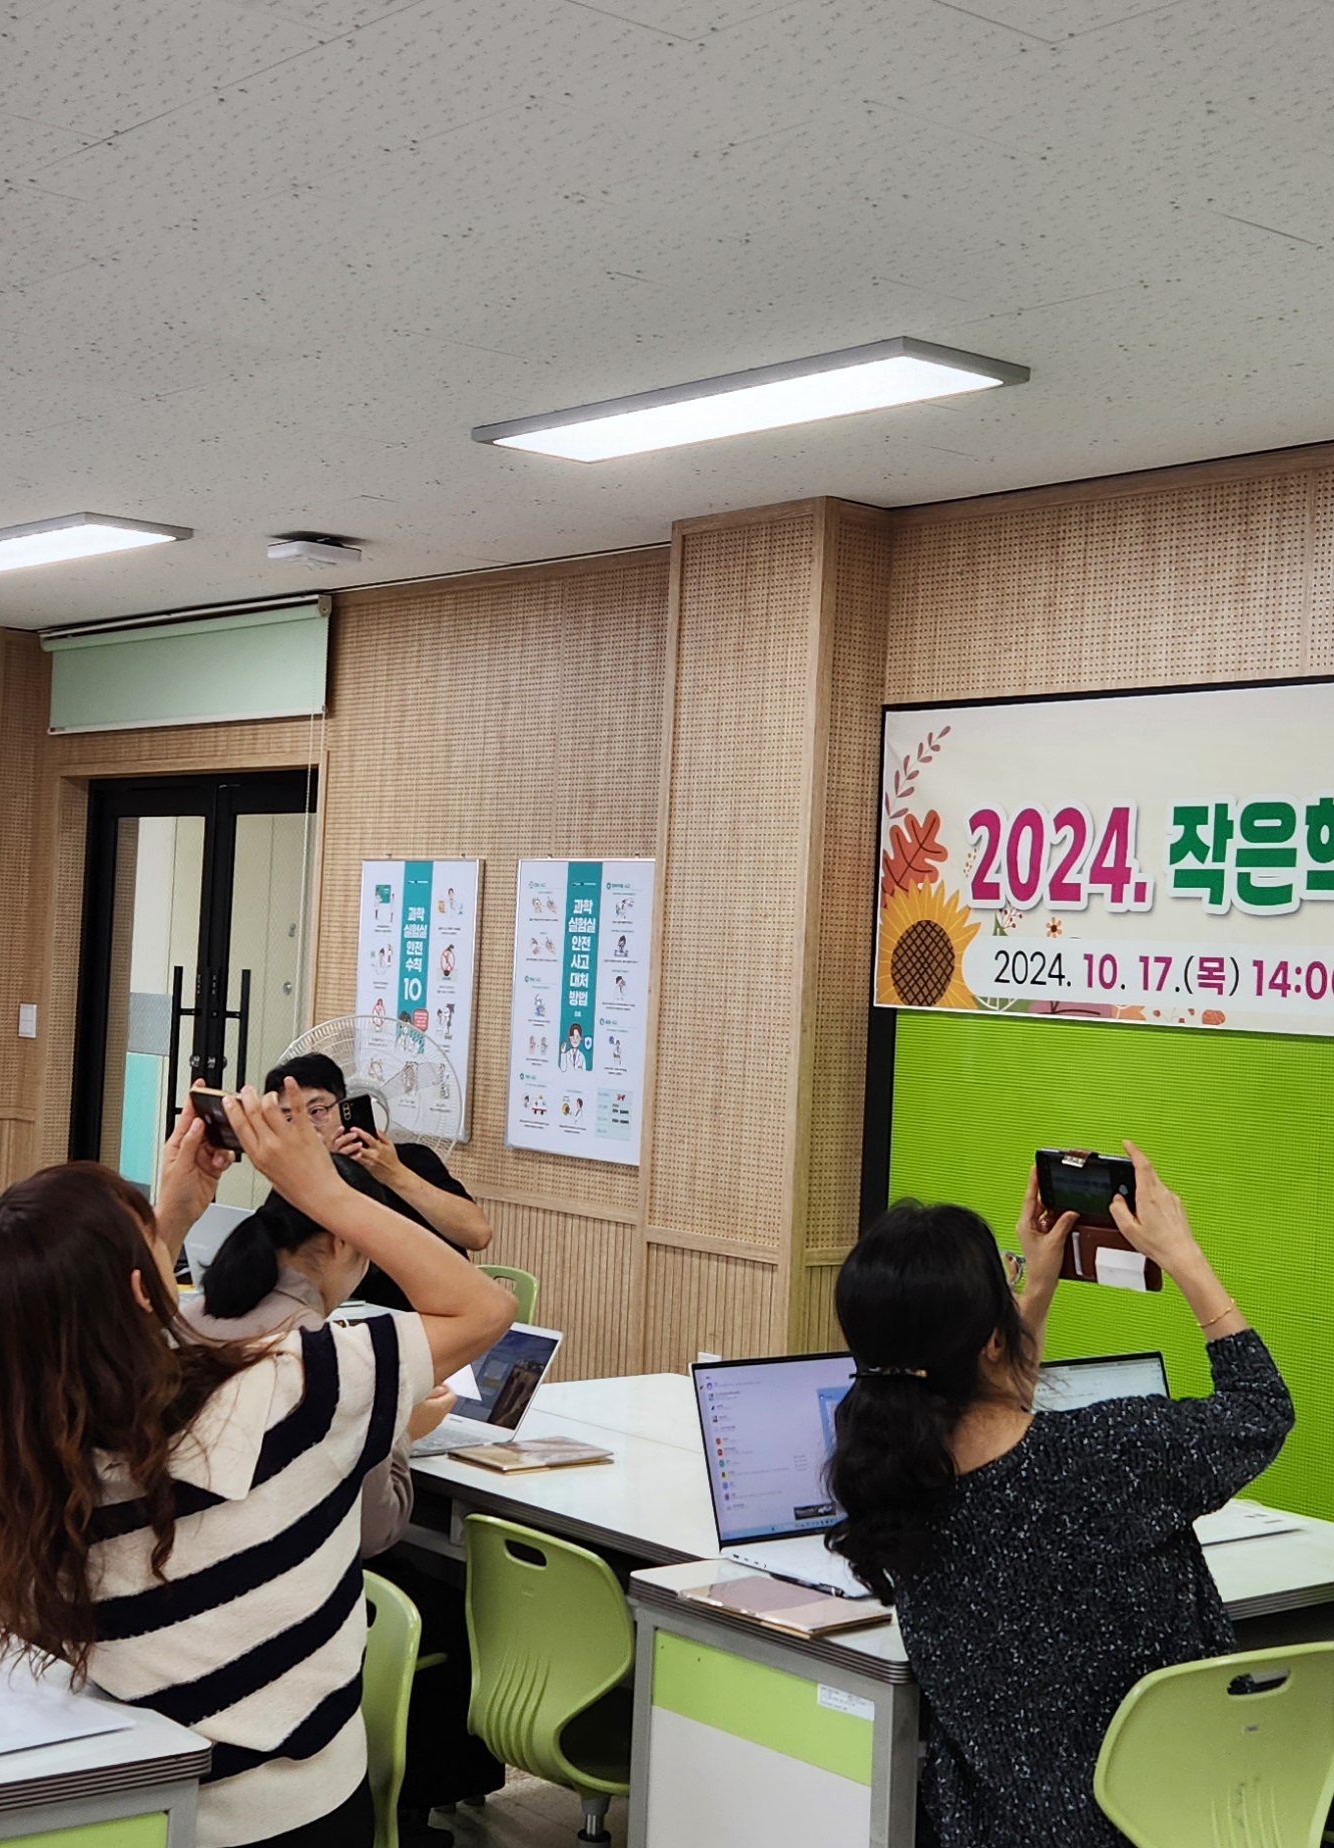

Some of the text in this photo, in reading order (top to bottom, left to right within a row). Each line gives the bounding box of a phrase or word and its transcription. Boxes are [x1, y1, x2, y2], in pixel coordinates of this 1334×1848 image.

[969, 805, 1146, 905] 2024.
[407, 907, 425, 922] 과학
[573, 899, 593, 915] 과학
[403, 924, 427, 939] 실험실
[568, 917, 596, 933] 실험실
[406, 940, 423, 956] 안전
[571, 935, 591, 952] 안전
[405, 957, 422, 973] 수칙
[570, 954, 589, 970] 사고
[569, 972, 589, 989] 대처
[994, 949, 1072, 988] 2024.
[1083, 953, 1126, 991] 10.
[1139, 955, 1240, 996] 17.(목)
[403, 977, 422, 1001] 10
[568, 990, 588, 1007] 방법
